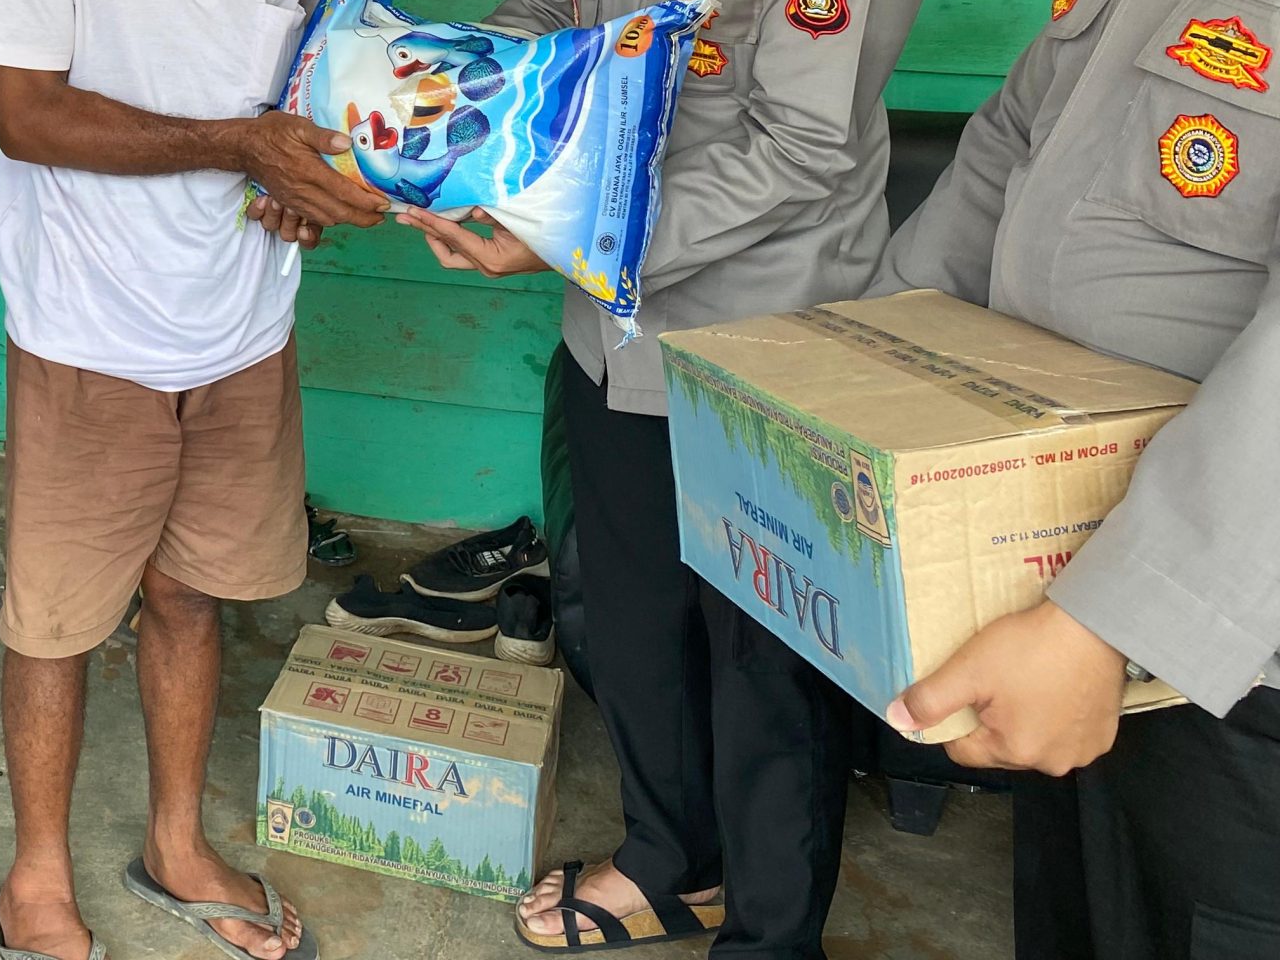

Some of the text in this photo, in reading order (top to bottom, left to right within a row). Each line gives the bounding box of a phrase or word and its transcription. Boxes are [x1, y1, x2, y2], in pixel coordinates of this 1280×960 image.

[620, 30, 640, 52] 10
[618, 127, 626, 150] OGAN
[611, 179, 620, 203] BUANA
[609, 205, 616, 217] CV
[1031, 452, 1056, 466] MD.
[1060, 449, 1073, 461] RI
[1078, 442, 1118, 459] BPOM
[910, 458, 1027, 485] 120682000200118
[735, 491, 813, 559] AIR MINERAL
[1032, 526, 1069, 541] KOTOR
[991, 535, 1007, 545] KG
[1010, 531, 1029, 543] 11.3
[722, 516, 845, 660] DAIRA
[288, 666, 543, 721] DAIRA DAIRA DAIRA DAIRA DAIRA DAIRA DAIRA
[425, 708, 441, 721] 8
[323, 735, 470, 799] DAIRA
[345, 783, 371, 800] AIR
[305, 841, 347, 857] ANUGERAH
[348, 851, 380, 865] TRIDAYA
